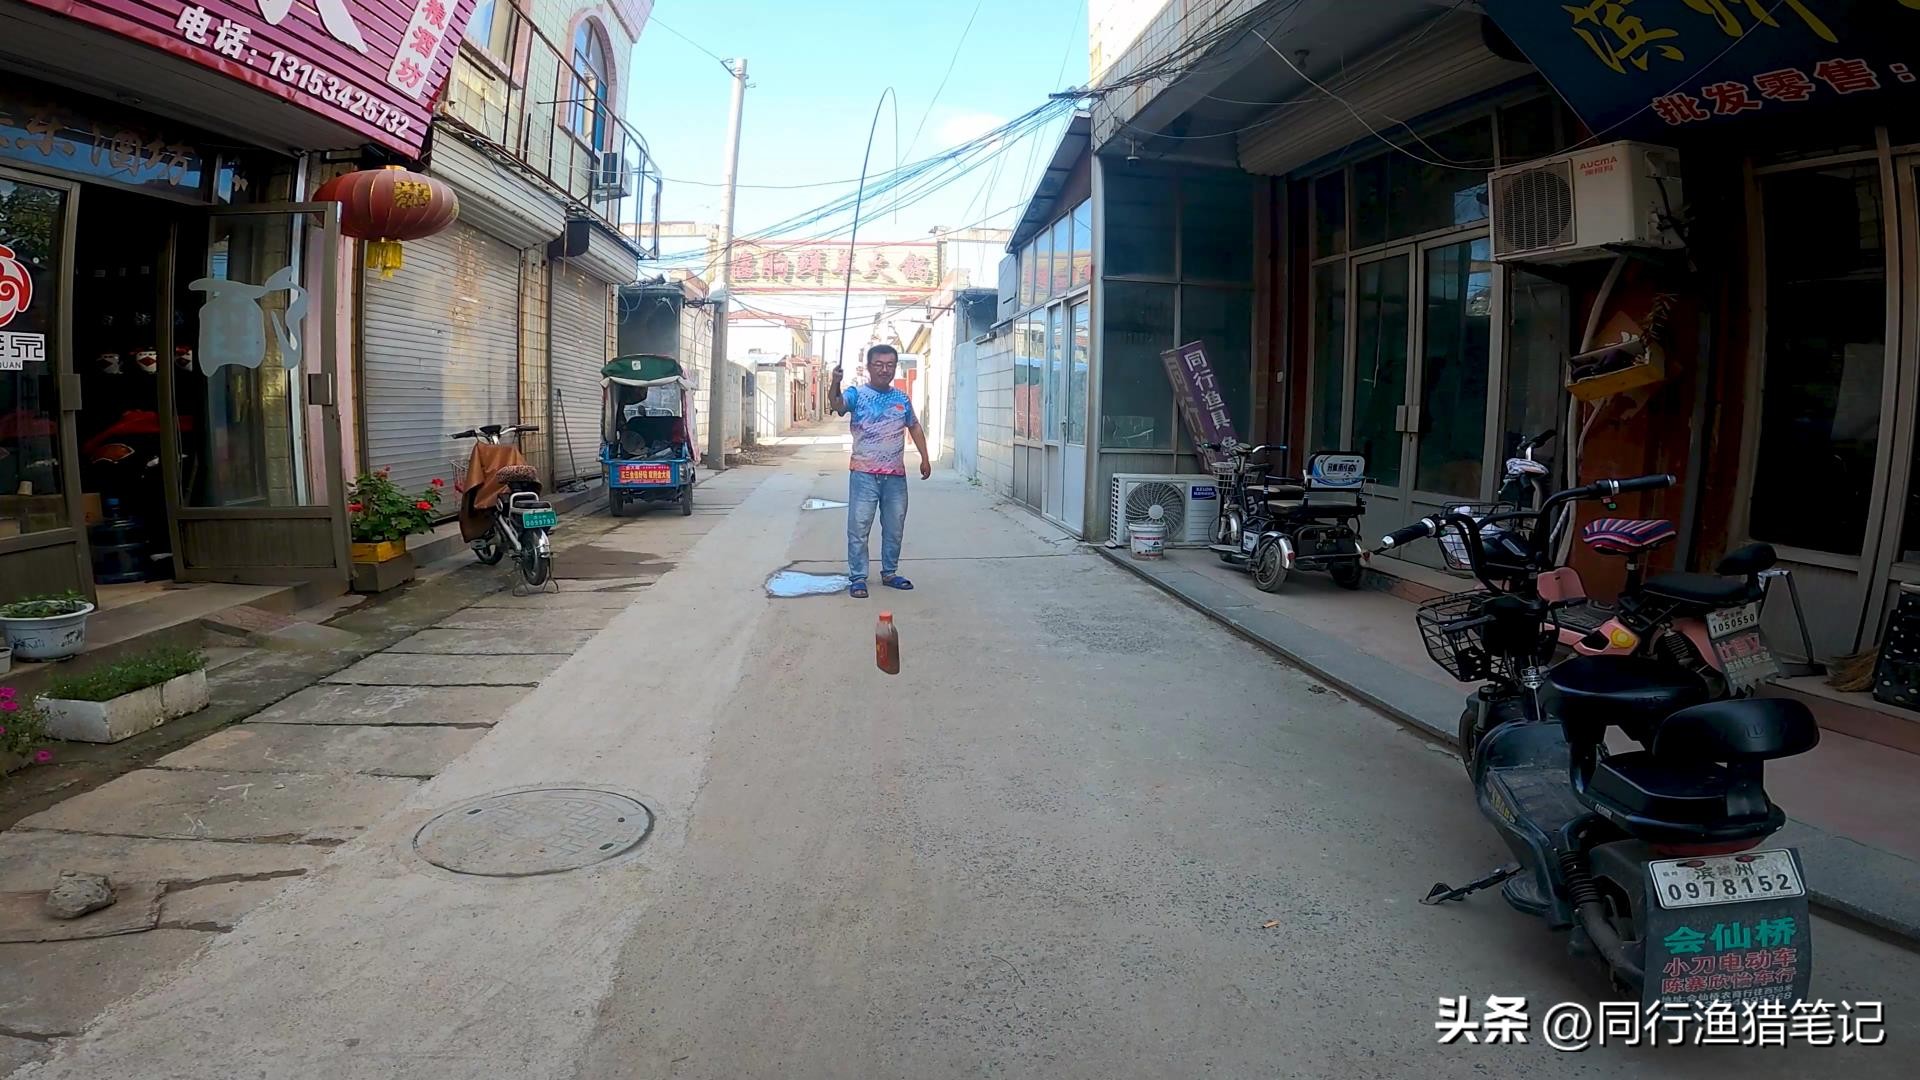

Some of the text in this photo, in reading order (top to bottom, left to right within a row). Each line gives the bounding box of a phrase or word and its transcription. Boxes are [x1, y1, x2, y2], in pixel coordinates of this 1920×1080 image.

[1712, 614, 1755, 633] 1050550
[1668, 873, 1792, 900] 0978152
[1663, 917, 1796, 954] 会仙桥
[1663, 948, 1798, 977] 小刀电动车
